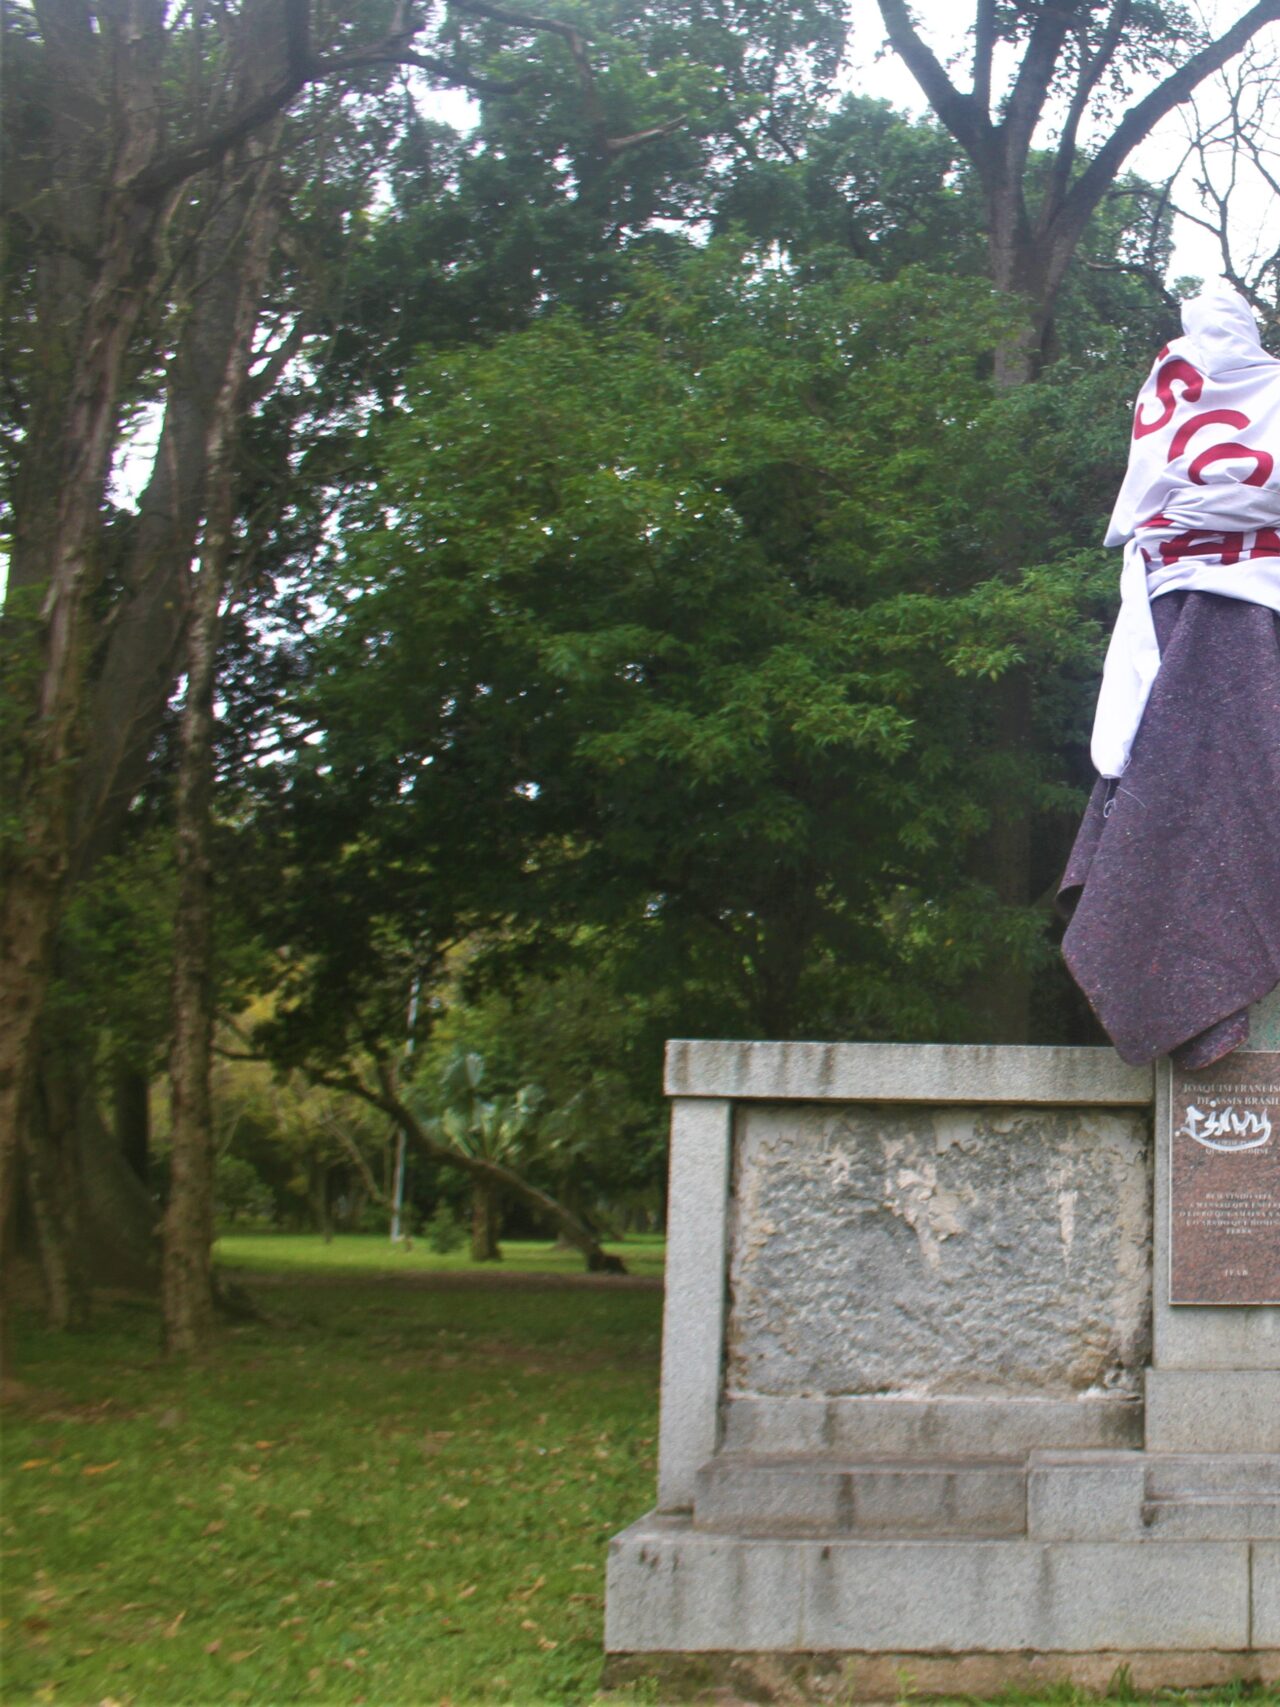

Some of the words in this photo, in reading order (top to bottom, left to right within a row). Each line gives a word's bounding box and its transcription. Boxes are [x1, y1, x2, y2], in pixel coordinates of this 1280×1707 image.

[1183, 1083, 1231, 1094] JOAQUIM
[1196, 1096, 1211, 1106] DE
[1215, 1096, 1243, 1106] ASSIS
[1244, 1096, 1280, 1106] BRASIL
